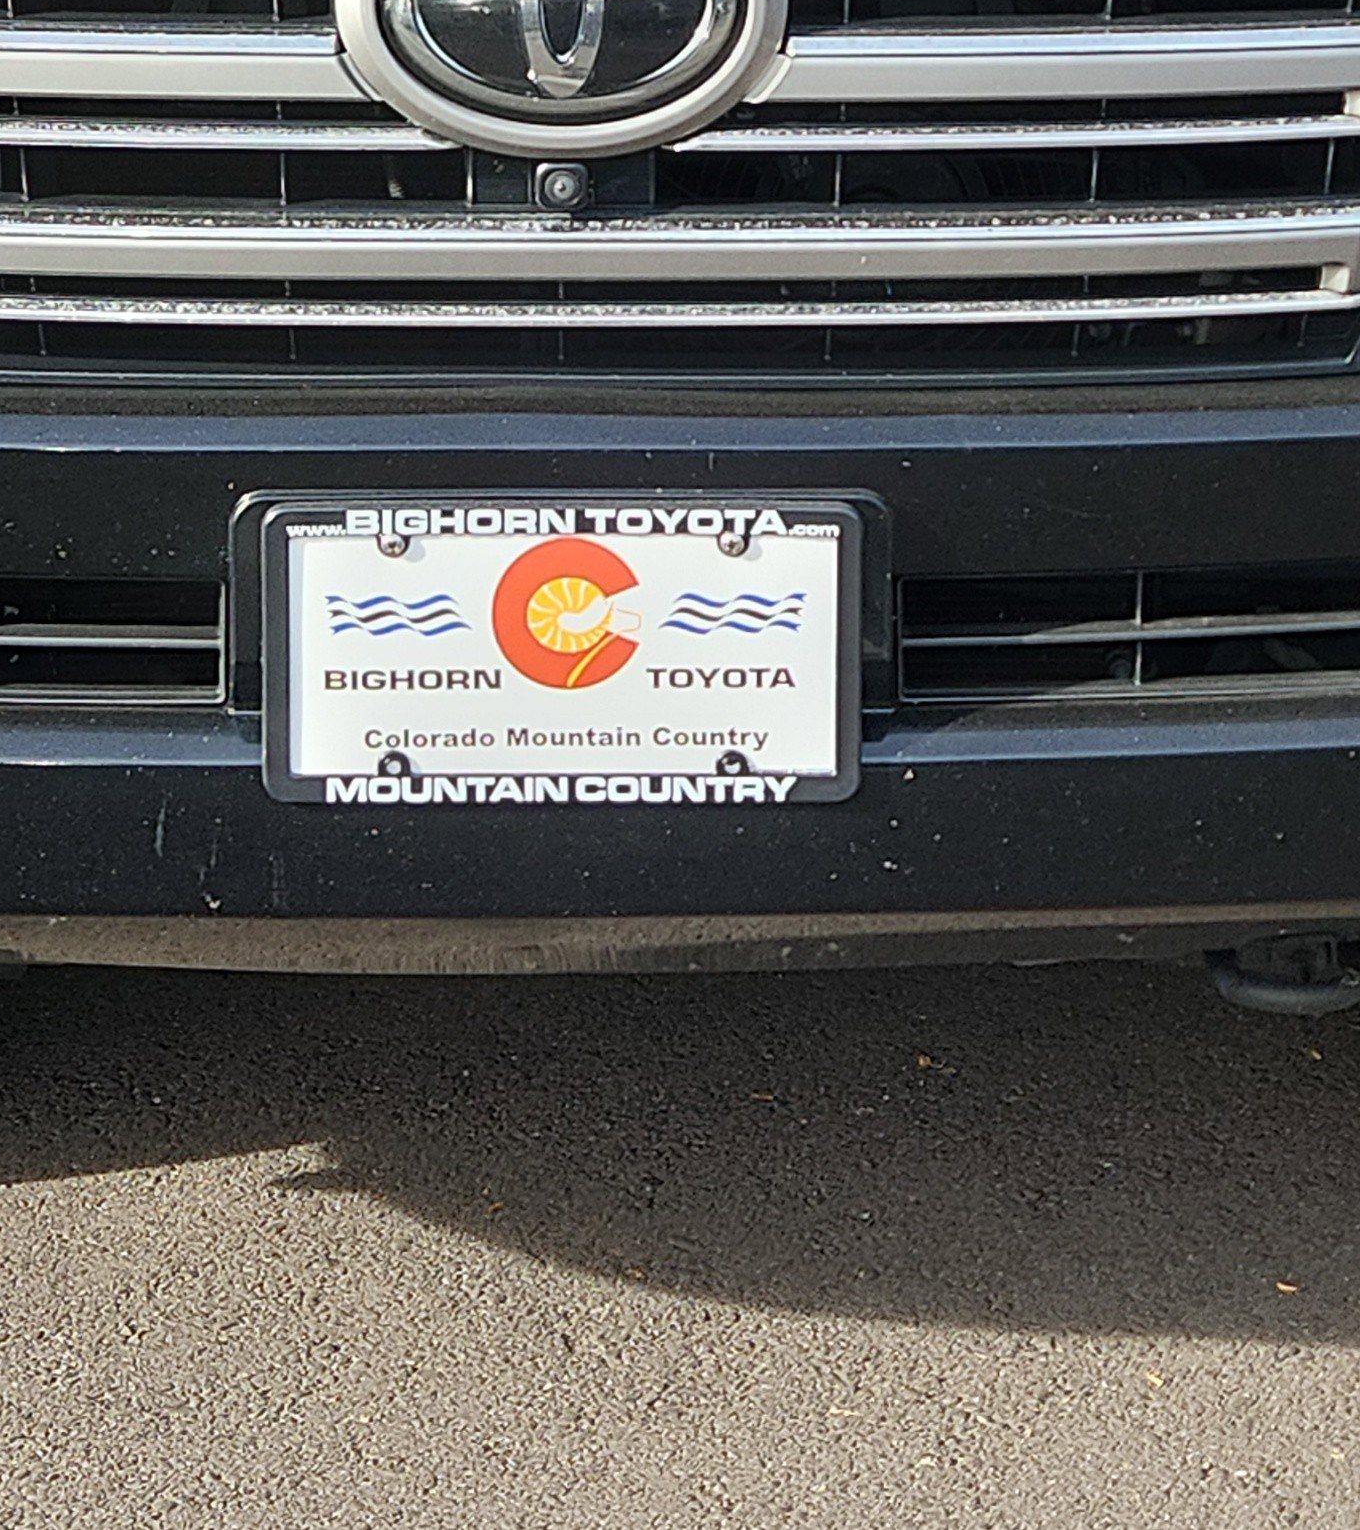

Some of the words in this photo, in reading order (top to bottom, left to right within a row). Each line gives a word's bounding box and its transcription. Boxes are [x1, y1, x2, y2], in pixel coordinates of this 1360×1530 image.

[324, 669, 502, 690] BIGHORN
[646, 667, 796, 689] TOYOTA
[364, 728, 495, 749] Colorado
[507, 726, 641, 747] Mountain
[652, 726, 769, 751] Country
[325, 775, 569, 804] MOUNTAIN
[574, 775, 798, 803] COUNTRY
